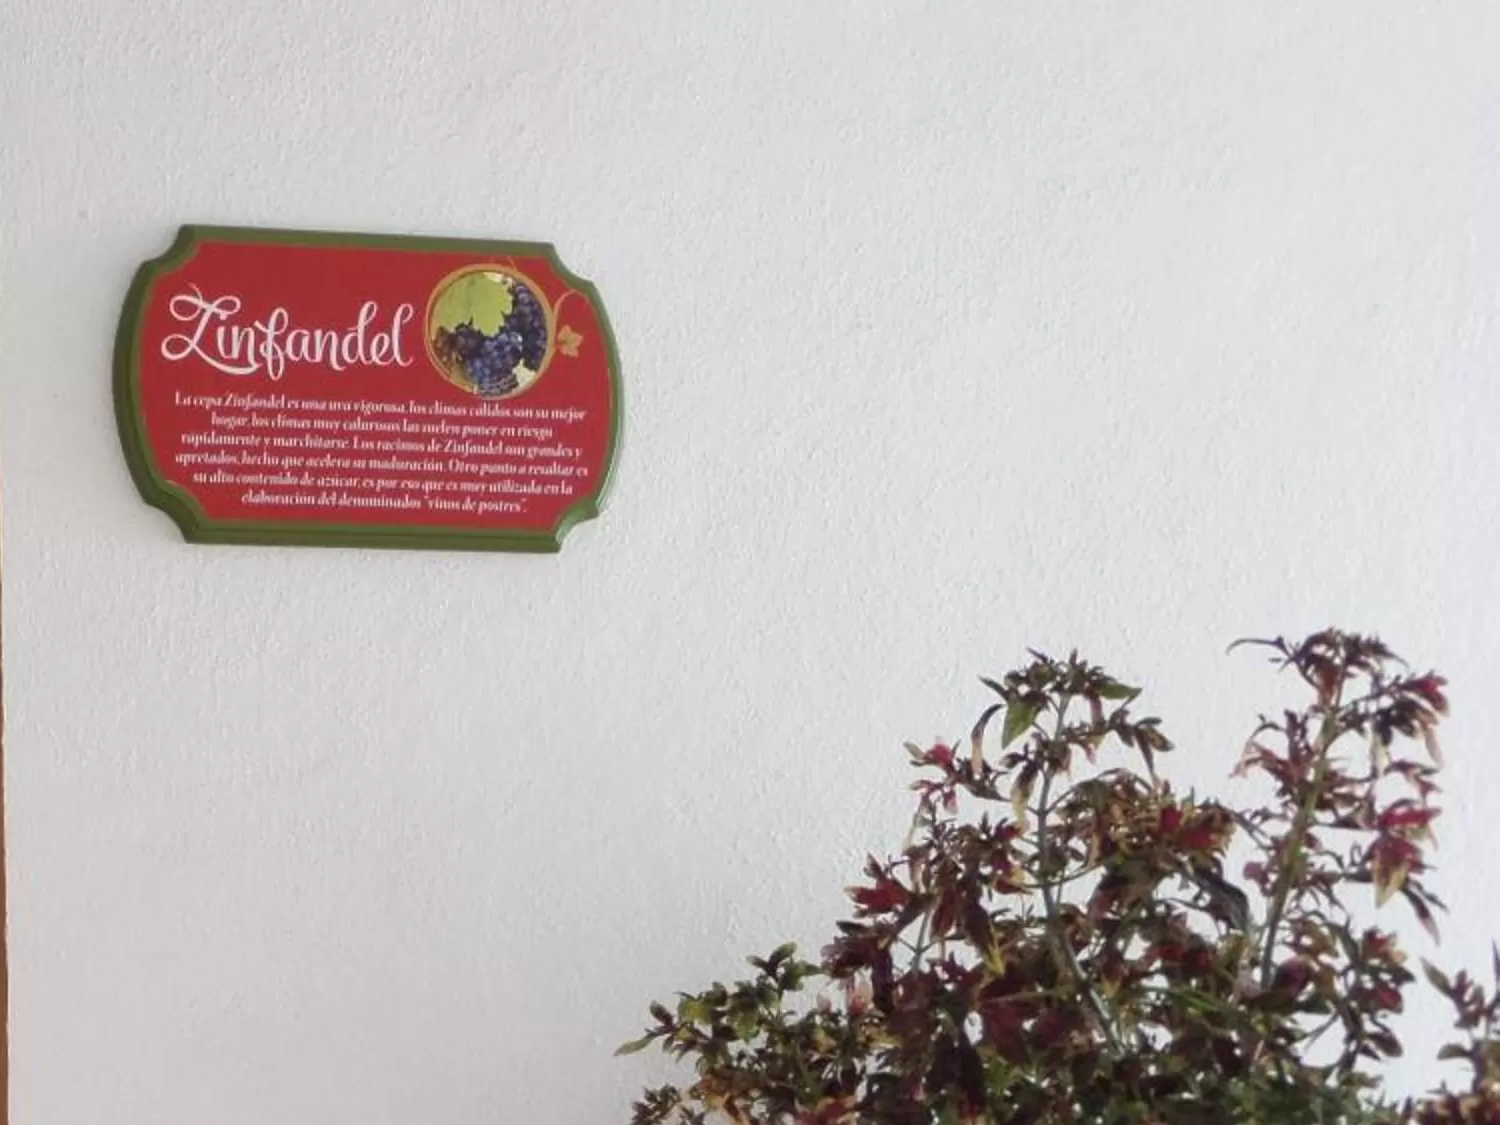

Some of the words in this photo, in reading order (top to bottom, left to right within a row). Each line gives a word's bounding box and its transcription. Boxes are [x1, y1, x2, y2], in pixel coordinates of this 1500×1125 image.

[161, 283, 414, 381] Zinfandel
[174, 390, 192, 406] La
[223, 391, 286, 412] Zinfandel
[409, 399, 426, 414] los
[428, 399, 467, 416] climas
[512, 407, 534, 418] son
[535, 407, 549, 419] su
[551, 407, 587, 424] mejor
[313, 419, 341, 434] muy
[500, 426, 515, 438] en
[352, 435, 375, 450] Los
[426, 437, 442, 453] de
[443, 439, 504, 458] Zinfandel
[527, 441, 574, 460] grandes
[281, 455, 304, 469] que
[448, 457, 479, 474] Otro
[192, 471, 207, 484] su
[299, 471, 315, 486] de
[421, 479, 444, 494] que
[543, 483, 560, 496] en
[561, 479, 574, 496] la
[461, 496, 477, 512] de
